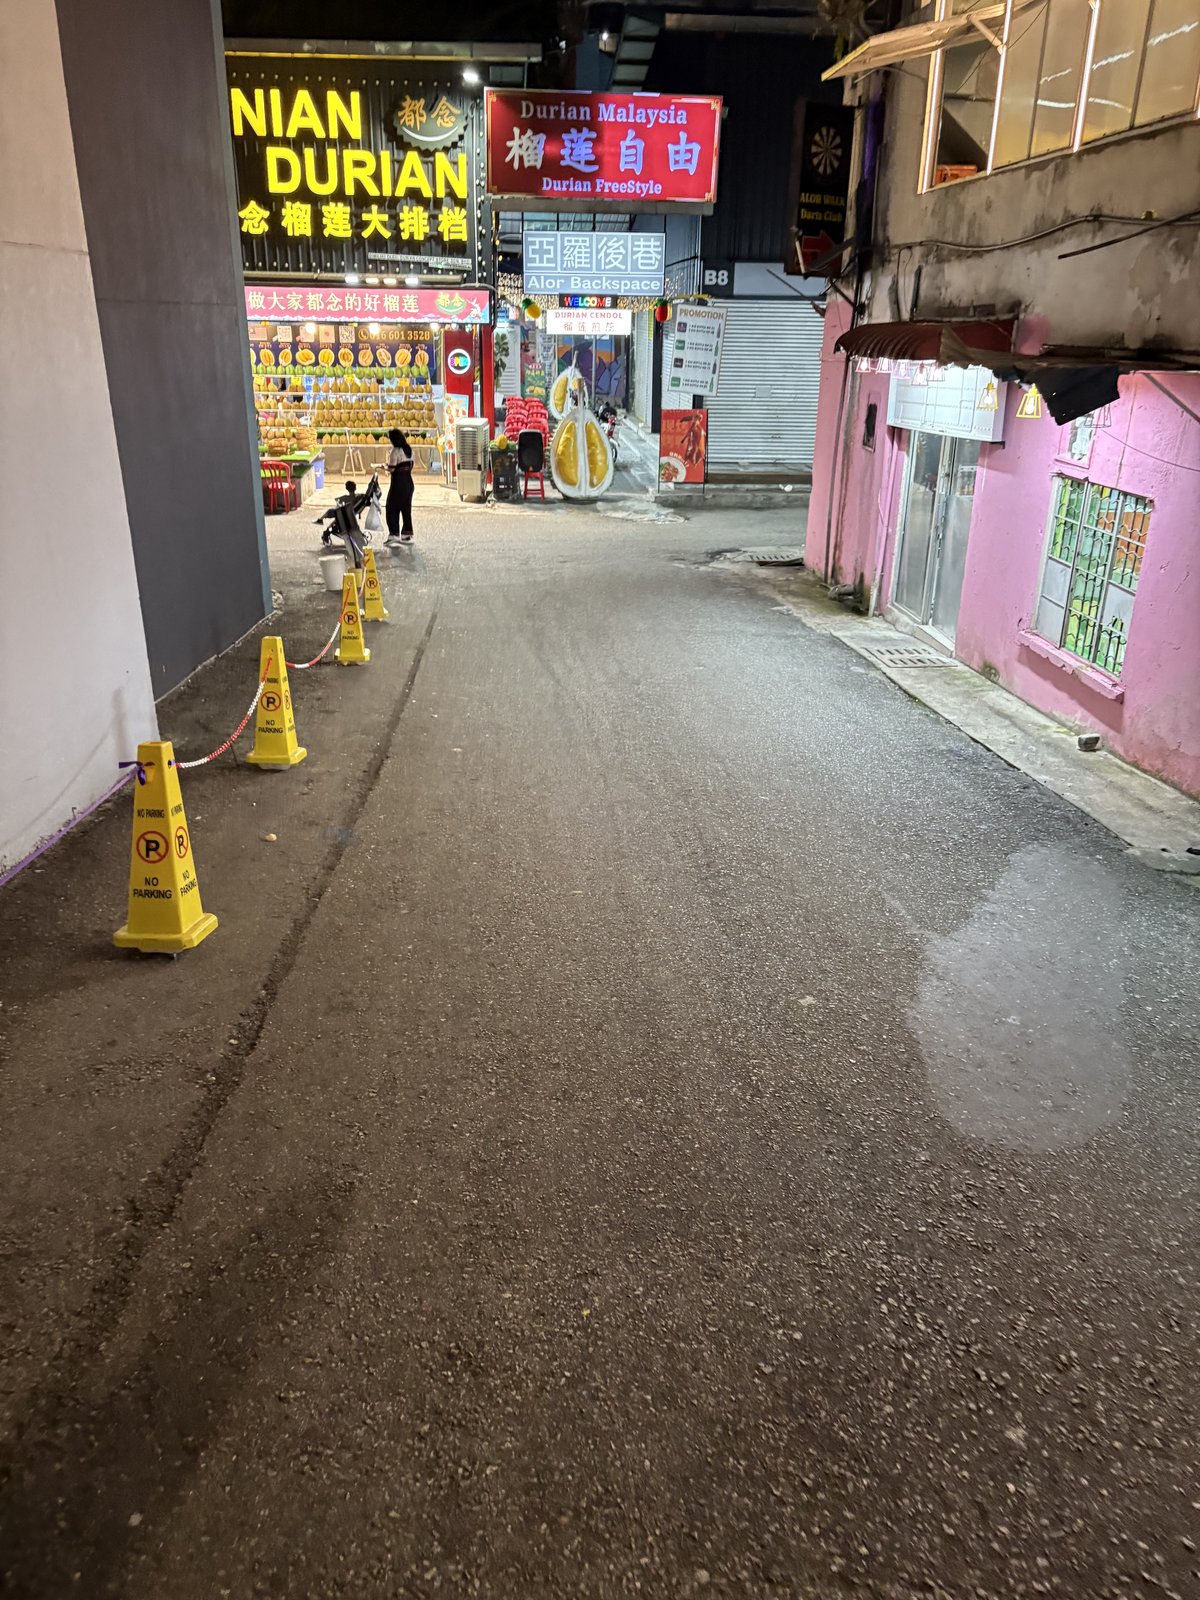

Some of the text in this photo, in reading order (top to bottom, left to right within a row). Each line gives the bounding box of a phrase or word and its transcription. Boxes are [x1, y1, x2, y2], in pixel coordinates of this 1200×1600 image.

[231, 88, 362, 140] NIAN
[397, 95, 461, 131] 都念
[520, 100, 688, 128] Durian Malaysia
[266, 146, 468, 199] DURIAN
[542, 177, 662, 197] Durian FreeStyle
[527, 236, 661, 270] 亞羅後巷
[527, 276, 661, 293] Alor Backspace
[704, 269, 729, 286] B8
[247, 291, 420, 313] 做大家都念的好榴莲
[563, 296, 612, 307] WELCOME
[679, 308, 724, 320] PROMOTION
[388, 330, 405, 340] 601
[407, 330, 431, 341] 3528
[137, 808, 144, 818] NO
[145, 808, 165, 818] PARKING
[144, 876, 159, 887] NO
[133, 888, 173, 899] PARKING
